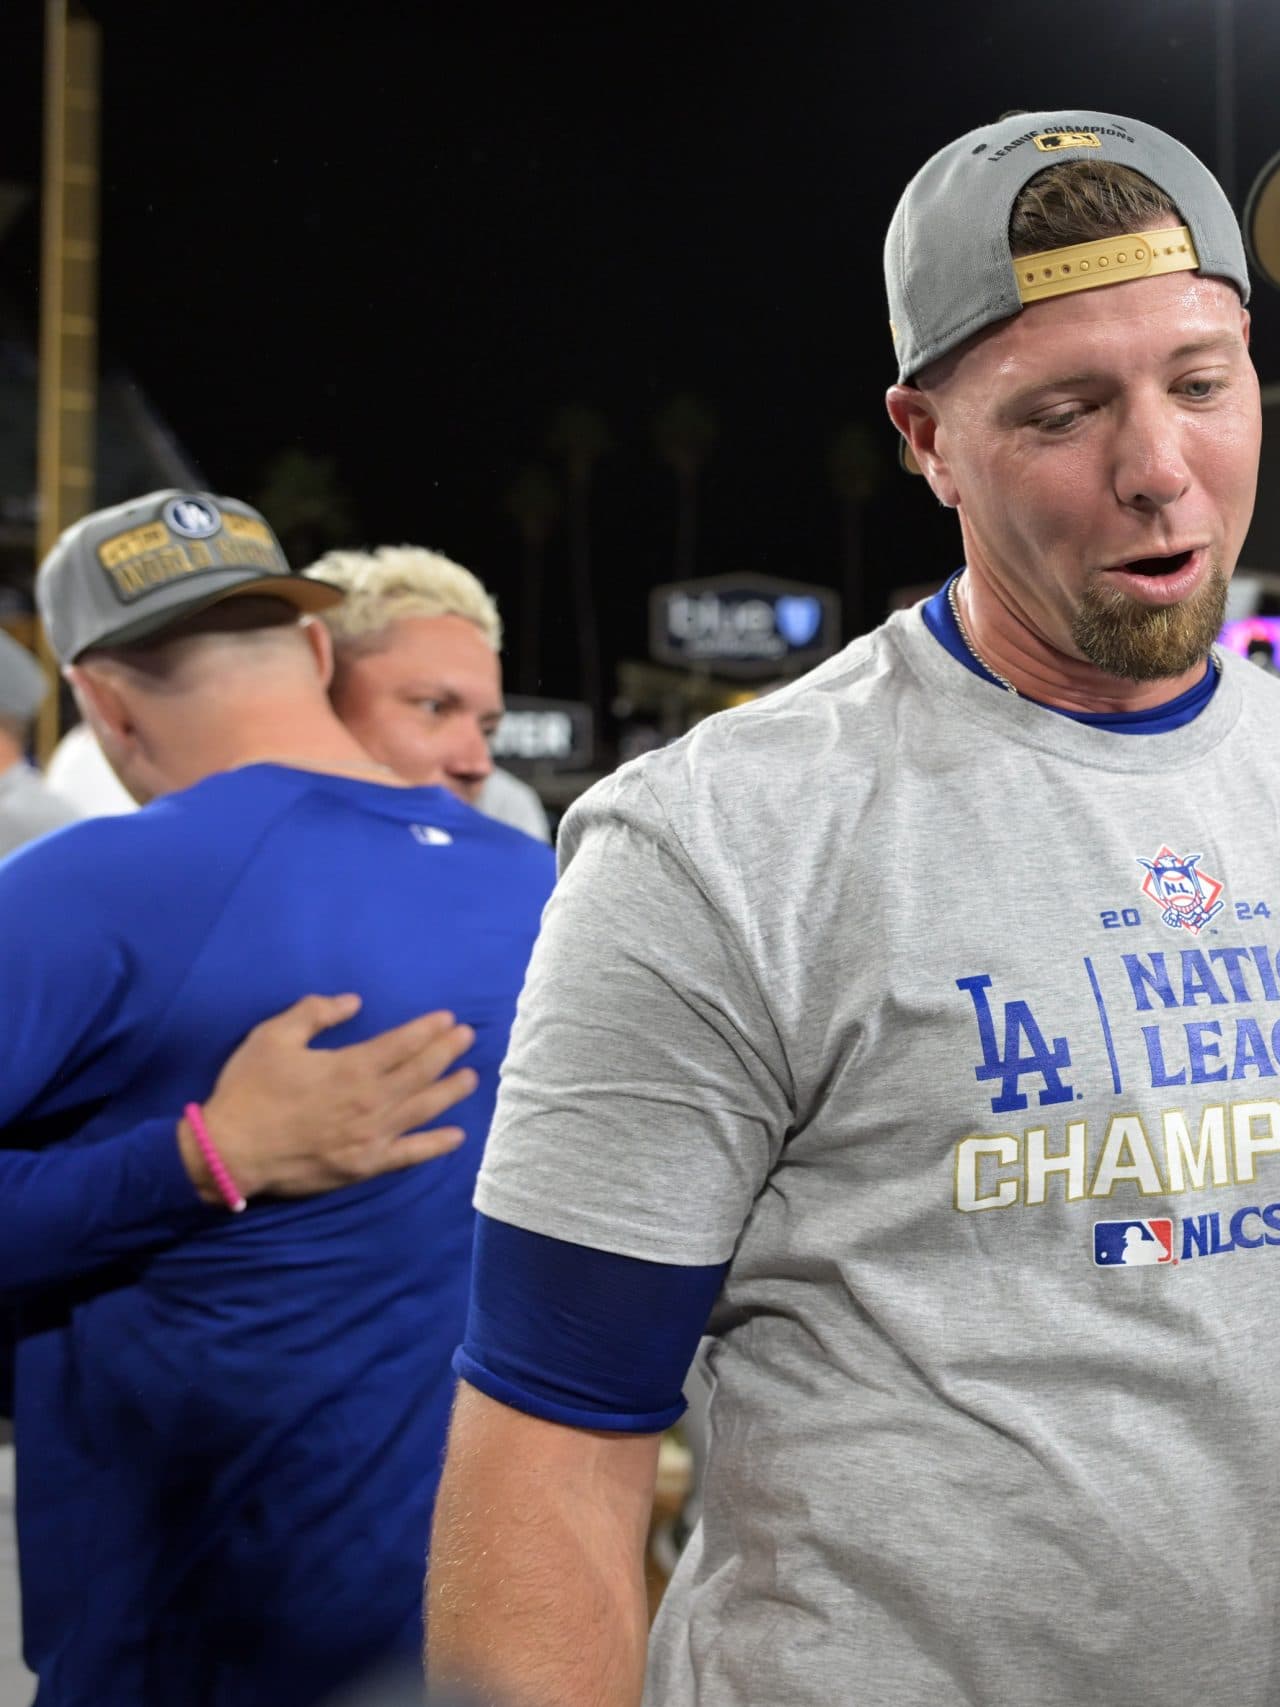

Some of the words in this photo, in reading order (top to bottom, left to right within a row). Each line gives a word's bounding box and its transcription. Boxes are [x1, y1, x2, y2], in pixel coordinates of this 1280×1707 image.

[988, 130, 1040, 162] LEAGUE
[1043, 125, 1136, 144] CHAMPIONS
[1163, 881, 1194, 896] N.L.
[1100, 908, 1141, 929] 20
[1236, 902, 1271, 921] 24
[955, 974, 1074, 1114] LA
